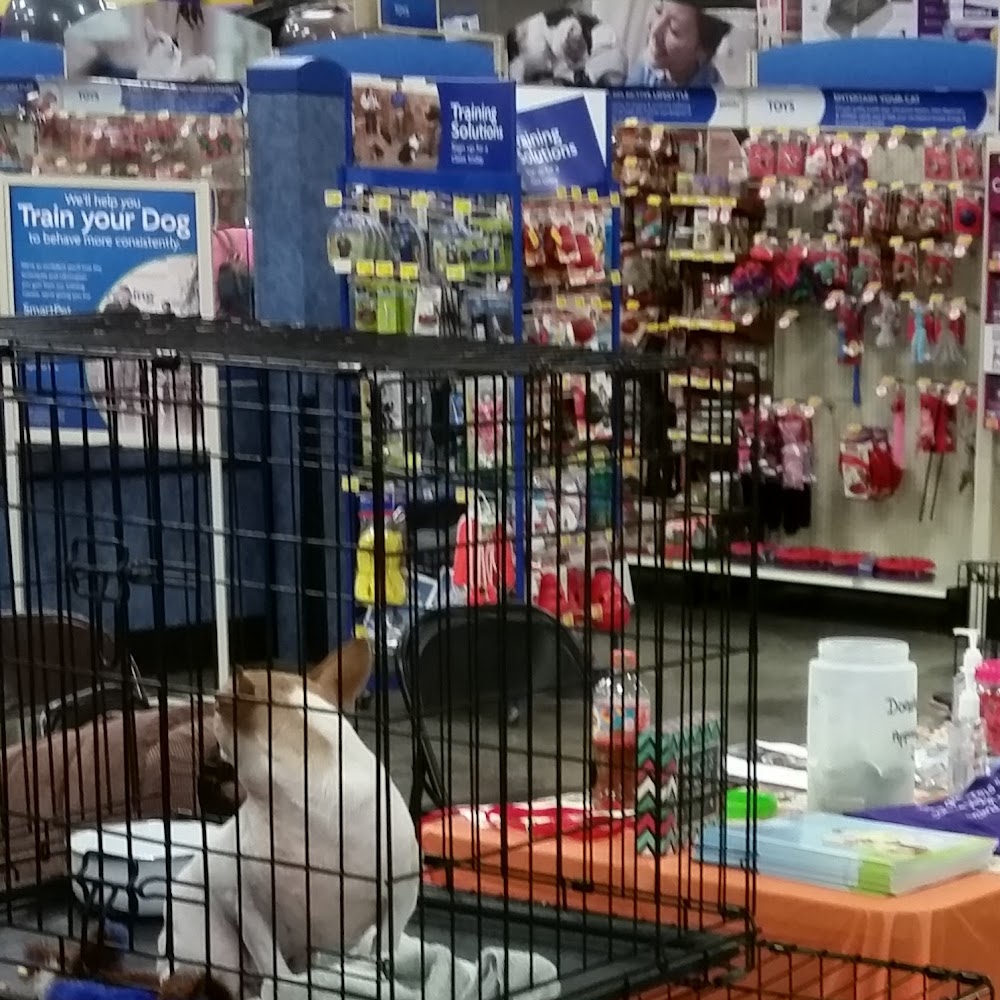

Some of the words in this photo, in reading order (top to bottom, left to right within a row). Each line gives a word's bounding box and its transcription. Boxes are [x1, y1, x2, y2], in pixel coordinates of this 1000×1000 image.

[451, 101, 498, 127] Training
[769, 100, 796, 113] TOYS
[451, 118, 504, 142] Solutions
[64, 192, 92, 208] We'll
[94, 193, 119, 210] help
[120, 195, 142, 212] you
[17, 201, 76, 230] Train
[81, 207, 136, 236] your
[141, 206, 192, 241] Dog
[28, 231, 41, 246] to
[43, 231, 82, 247] behave
[83, 233, 112, 248] more
